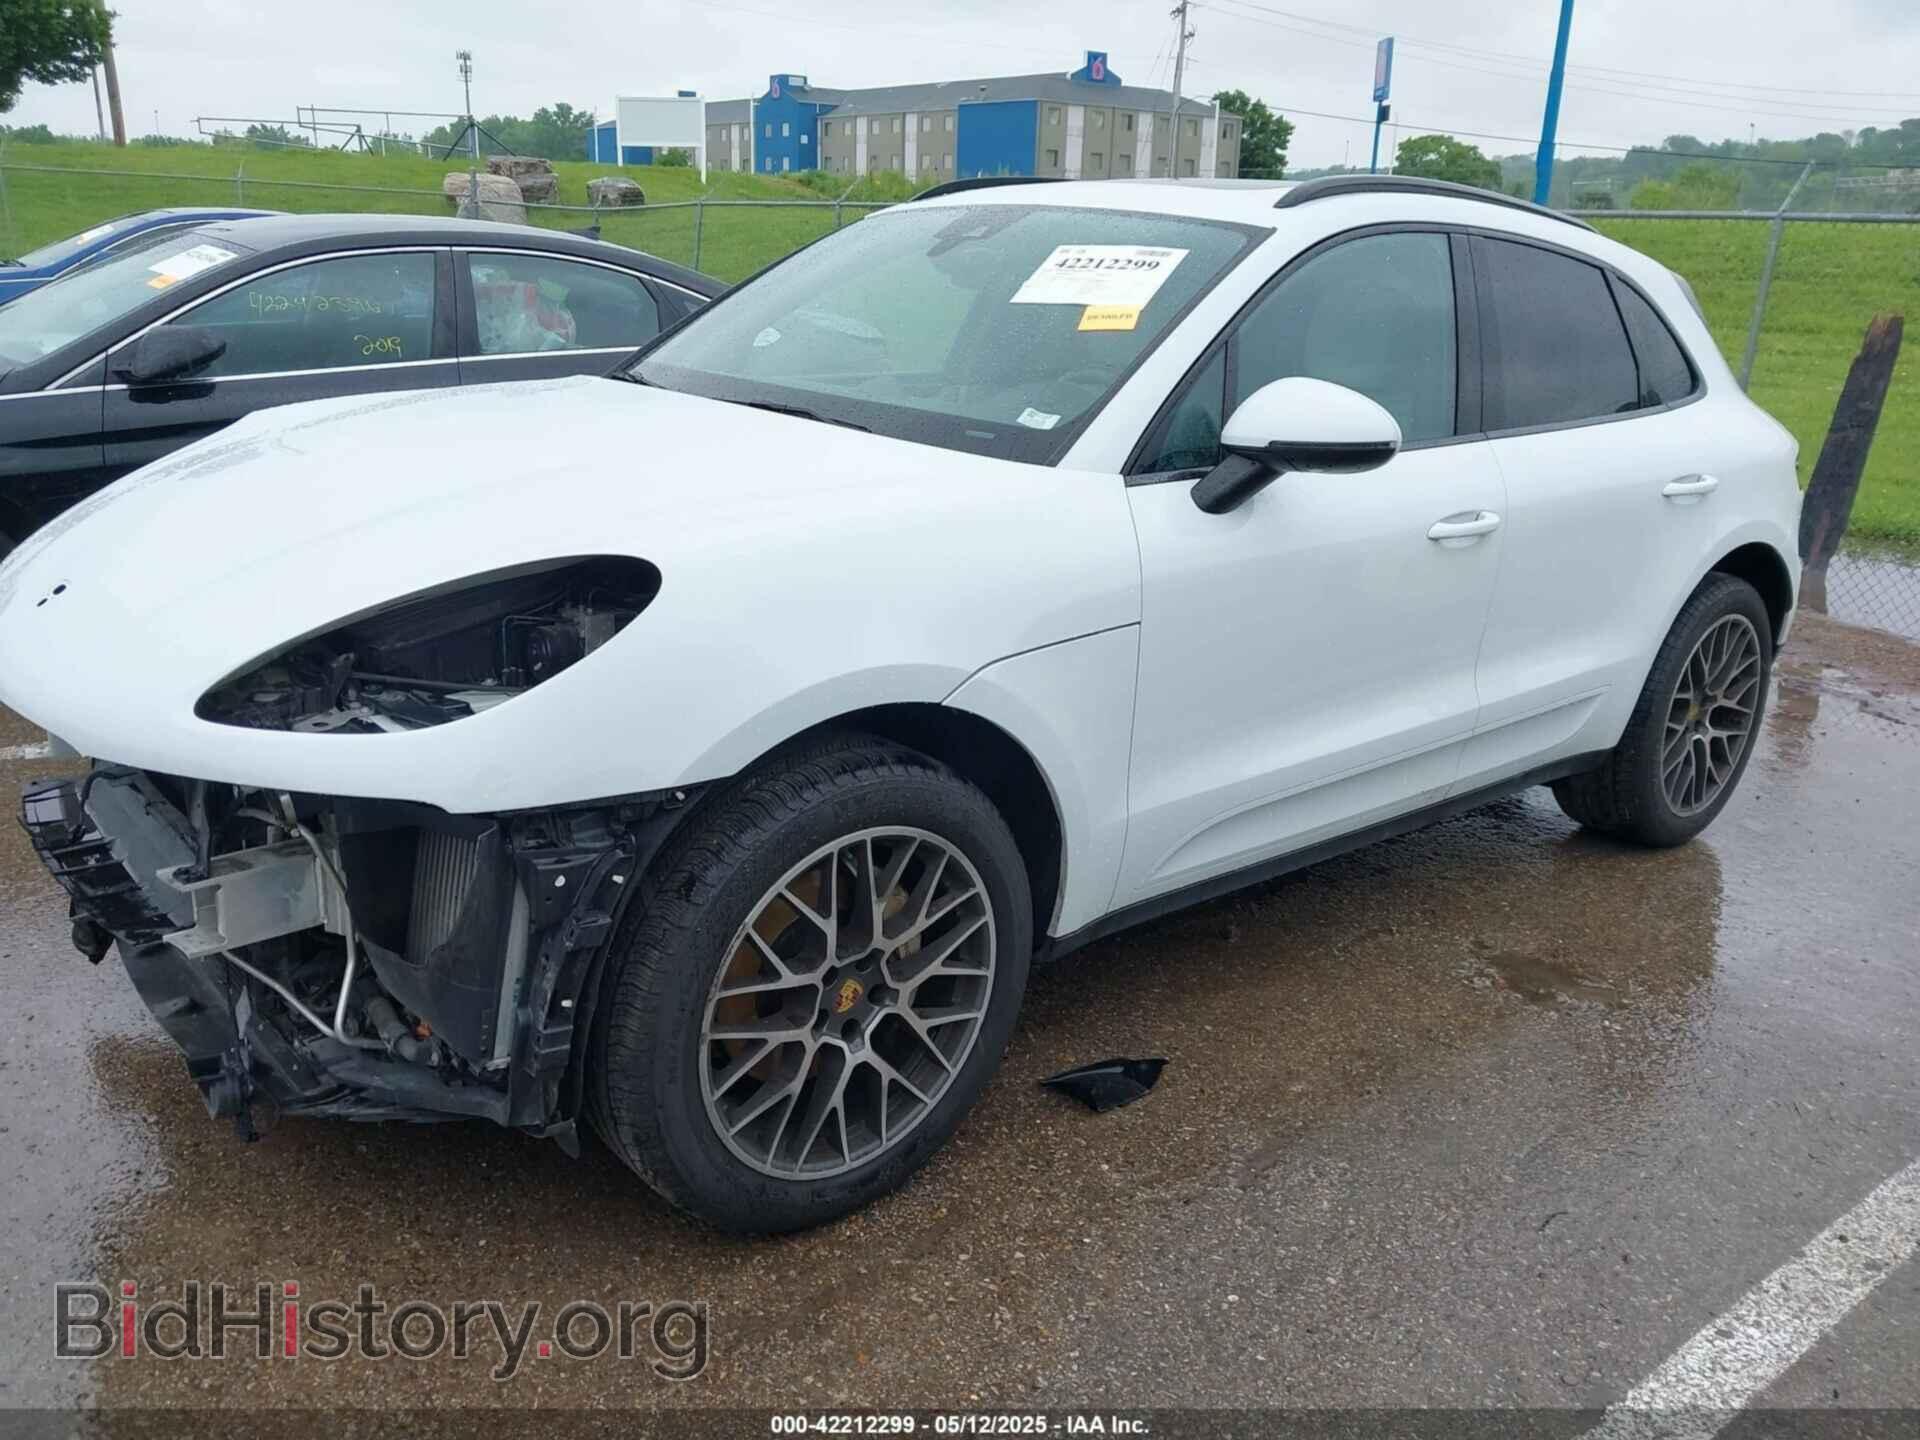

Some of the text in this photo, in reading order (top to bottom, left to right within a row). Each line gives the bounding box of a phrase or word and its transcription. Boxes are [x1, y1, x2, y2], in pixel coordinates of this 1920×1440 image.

[1091, 56, 1105, 81] 6
[1055, 256, 1160, 271] 42212299
[353, 334, 402, 358] 2019
